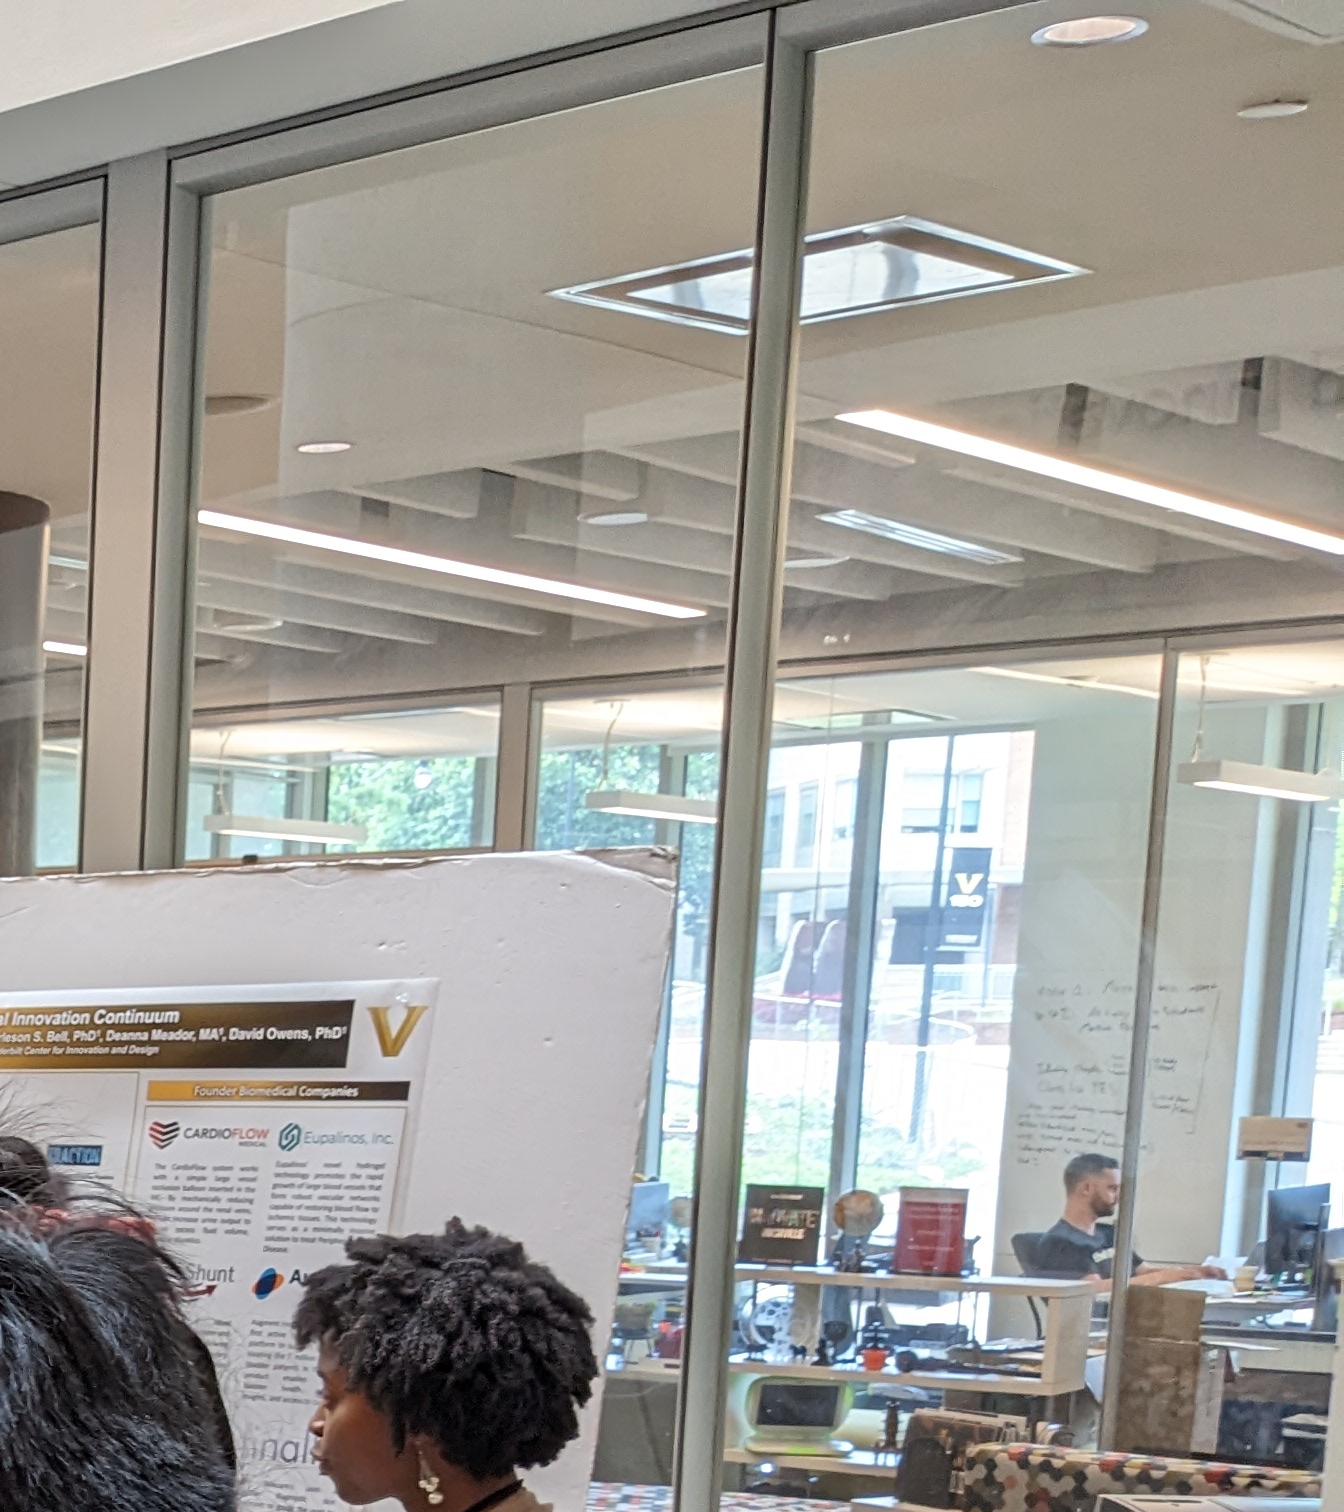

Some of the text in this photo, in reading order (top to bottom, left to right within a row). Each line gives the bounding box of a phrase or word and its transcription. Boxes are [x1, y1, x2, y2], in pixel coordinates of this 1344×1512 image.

[13, 1010, 90, 1026] Innovation
[94, 1008, 181, 1024] Continuum
[33, 1031, 44, 1043] S.
[106, 1030, 149, 1042] Deanna
[151, 1029, 197, 1042] Meador,
[229, 1026, 263, 1041] David
[266, 1027, 312, 1042] Owens,
[367, 1005, 429, 1058] V
[193, 1085, 359, 1099] Founder Biomedical Companies
[183, 1127, 270, 1140] CARDIOFLOW
[304, 1131, 394, 1146] Eupalinos, Inc.
